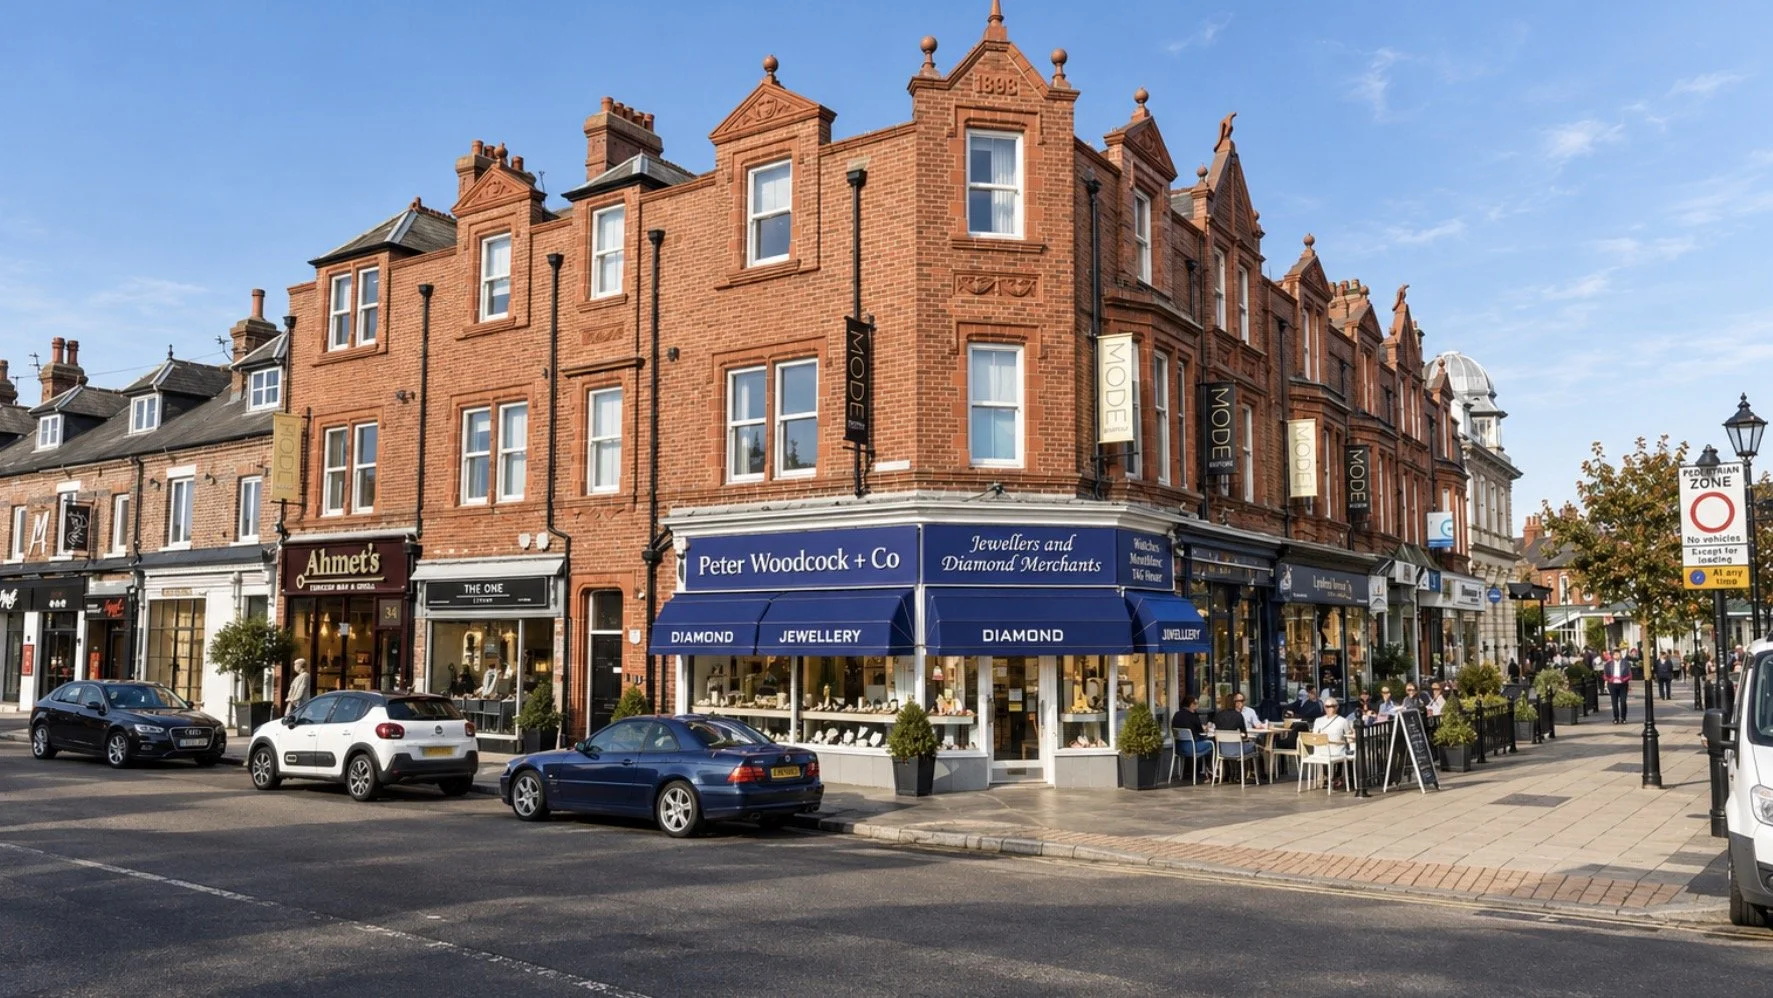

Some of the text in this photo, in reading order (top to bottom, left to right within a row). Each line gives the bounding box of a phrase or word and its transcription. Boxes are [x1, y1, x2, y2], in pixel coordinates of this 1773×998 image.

[850, 330, 865, 420] MODE
[1105, 343, 1127, 425] MODE
[1211, 388, 1232, 460] MODE
[1349, 449, 1366, 502] MODE
[1690, 476, 1732, 489] ZONE
[969, 533, 1077, 553] Jewellers and
[1687, 534, 1741, 544] No vehicles
[304, 543, 381, 577] Ahmet's
[699, 547, 901, 576] Peter Woodcock + Co
[941, 554, 1102, 573] Diamond Merchants
[1713, 569, 1743, 578] At any
[464, 583, 504, 594] THE ONE
[384, 606, 398, 619] 34
[671, 631, 734, 643] DIAMOND
[779, 630, 861, 643] JEWELLERY
[982, 629, 1064, 642] DIAMOND
